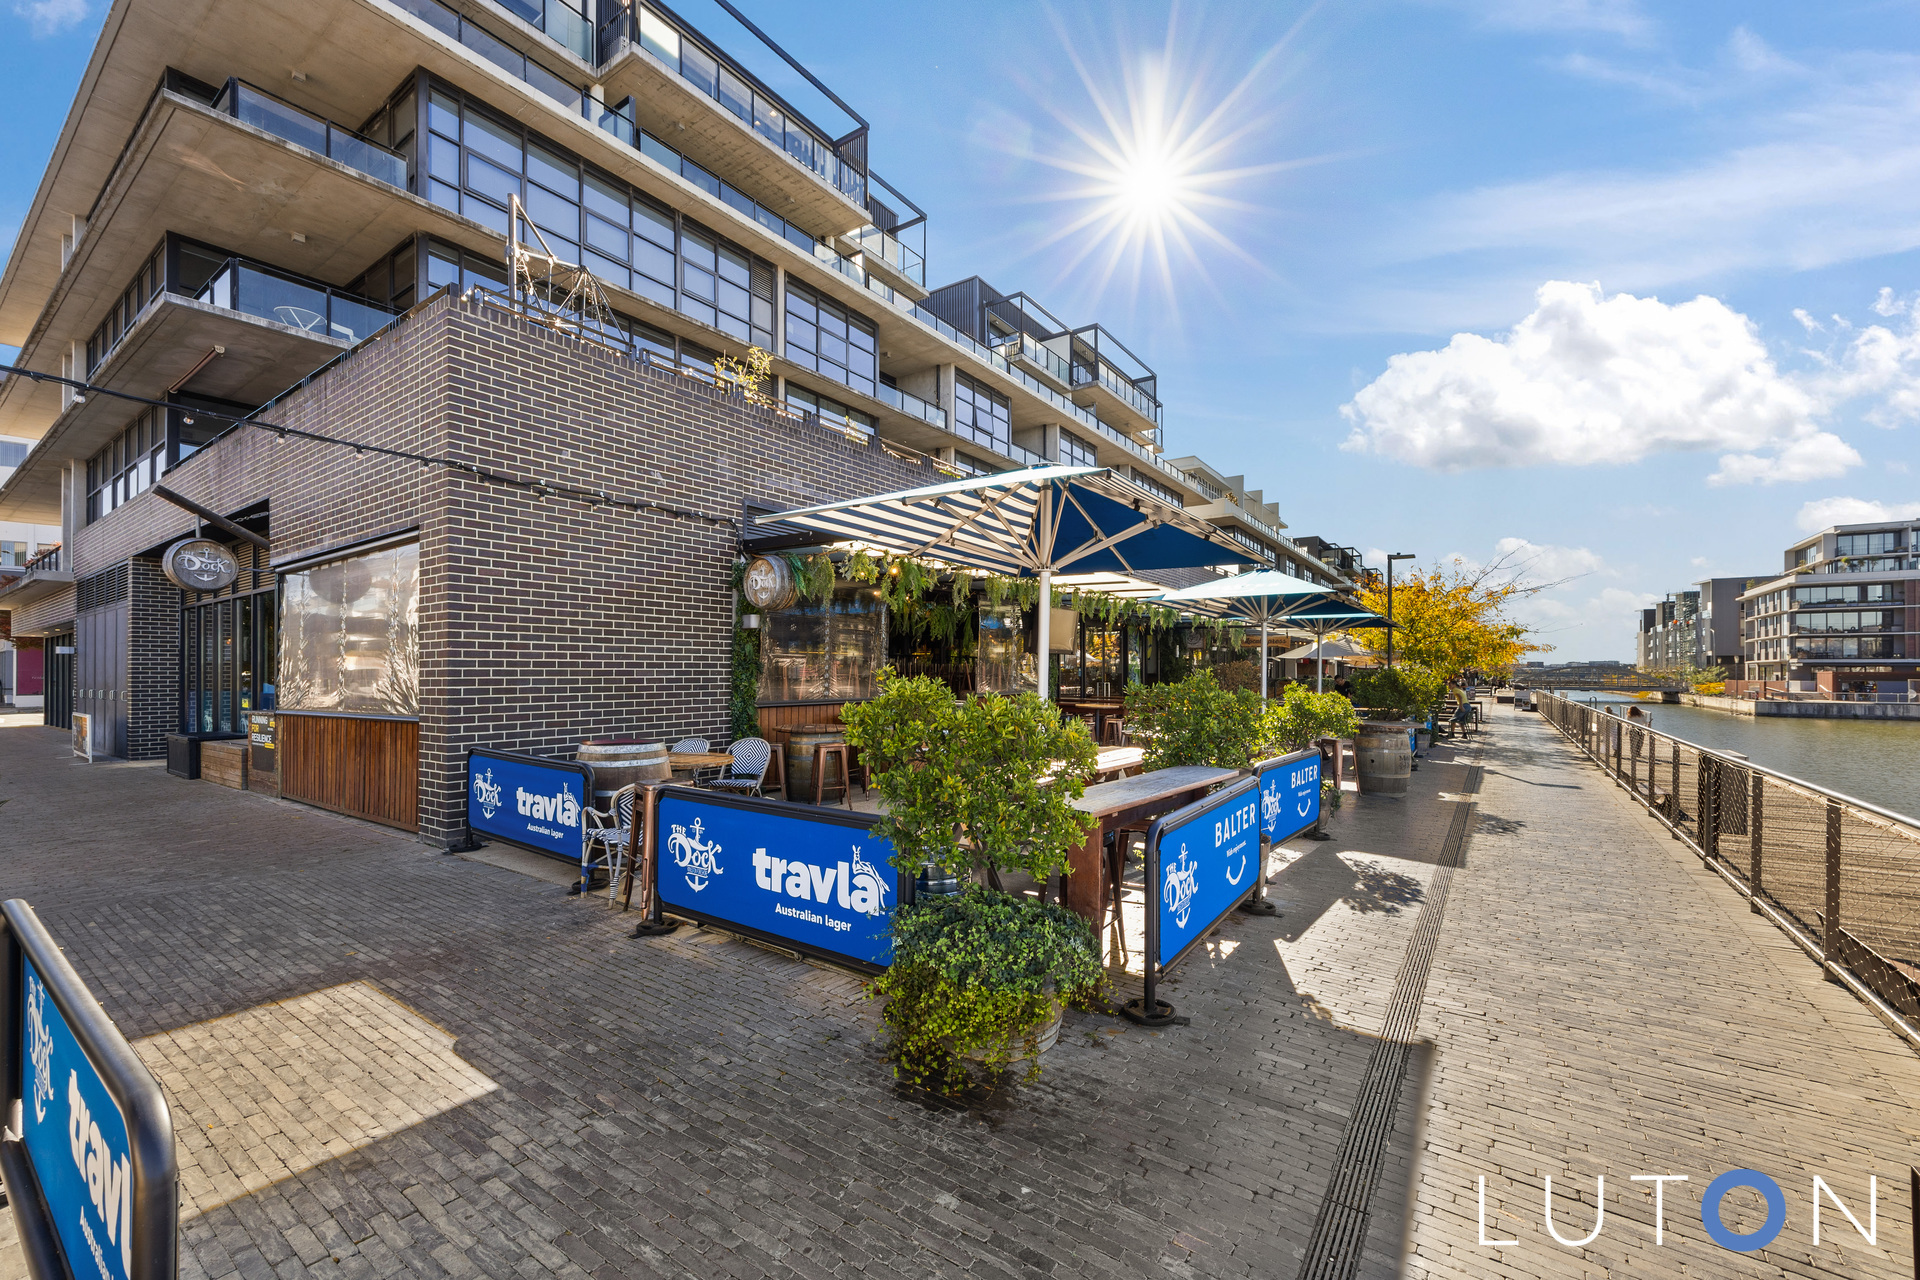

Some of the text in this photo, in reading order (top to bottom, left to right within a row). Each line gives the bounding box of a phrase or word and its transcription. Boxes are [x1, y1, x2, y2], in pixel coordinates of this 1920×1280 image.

[251, 724, 259, 732] FOR
[252, 715, 268, 724] RUNNING
[1291, 765, 1318, 789] BALTER
[516, 787, 576, 828] travla
[527, 823, 564, 839] Australian lager
[671, 824, 687, 836] THE
[1215, 803, 1256, 848] BALTER
[668, 833, 724, 875] Dock
[752, 848, 880, 916] travla
[775, 903, 852, 932] Australian lager
